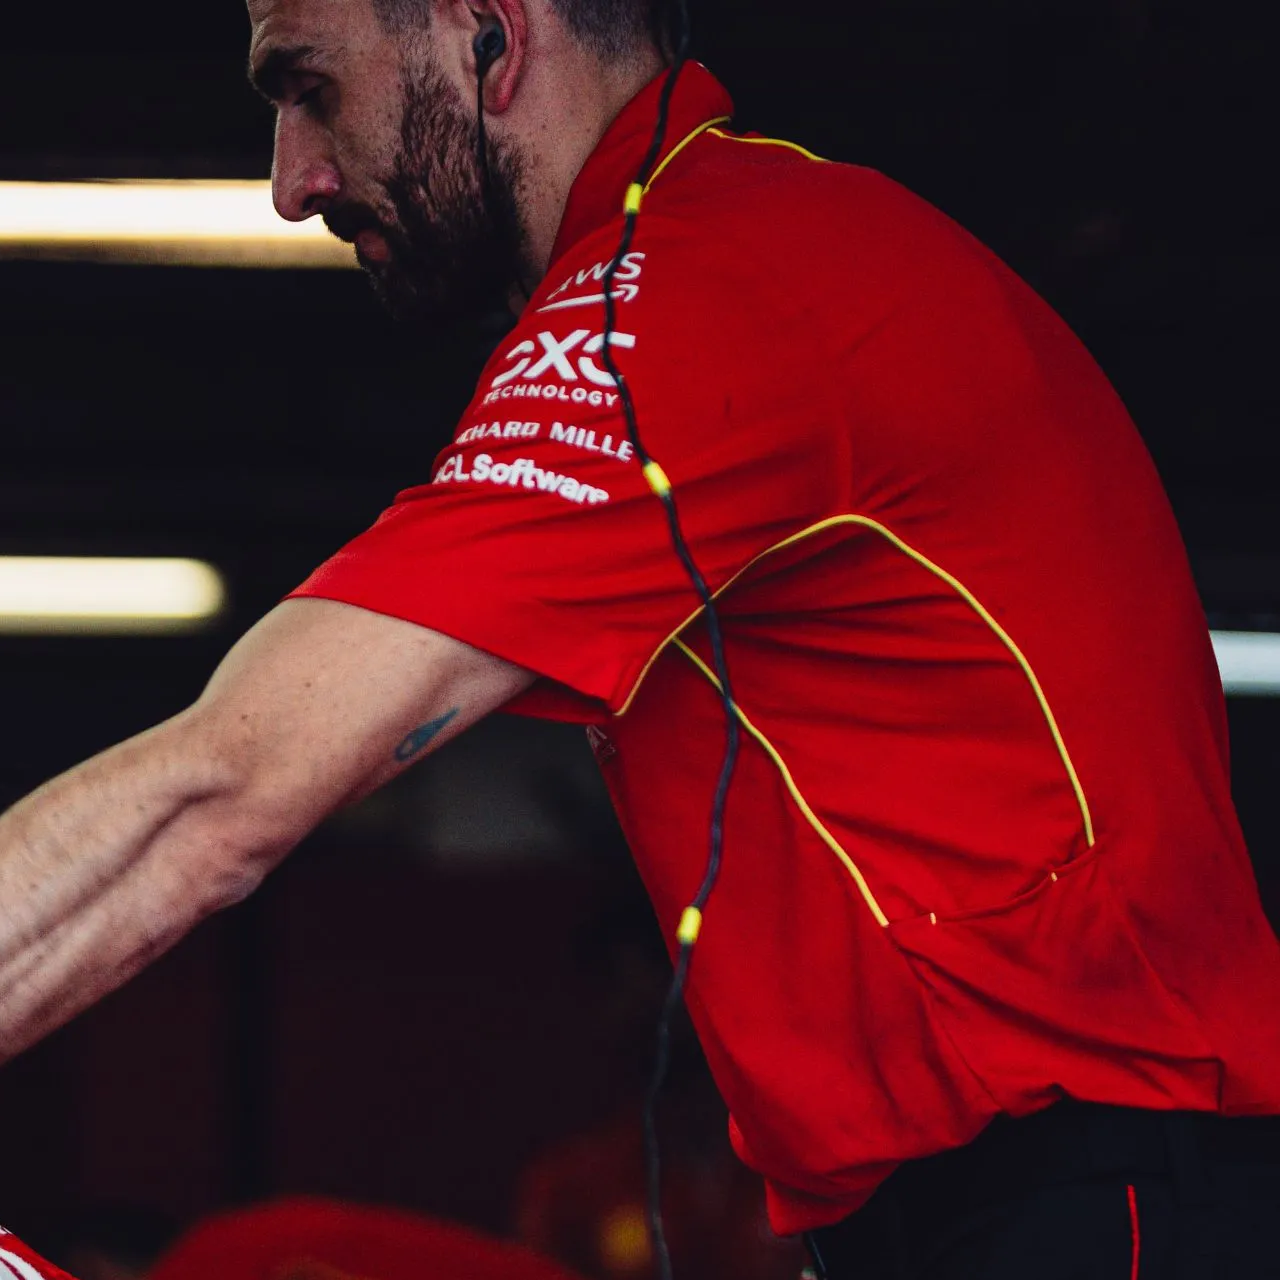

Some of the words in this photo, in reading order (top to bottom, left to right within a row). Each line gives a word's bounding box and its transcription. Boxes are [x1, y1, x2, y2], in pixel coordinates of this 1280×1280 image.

[456, 421, 541, 444] ICHARD
[550, 422, 635, 462] MILLE
[432, 454, 610, 505] CLSoftware
